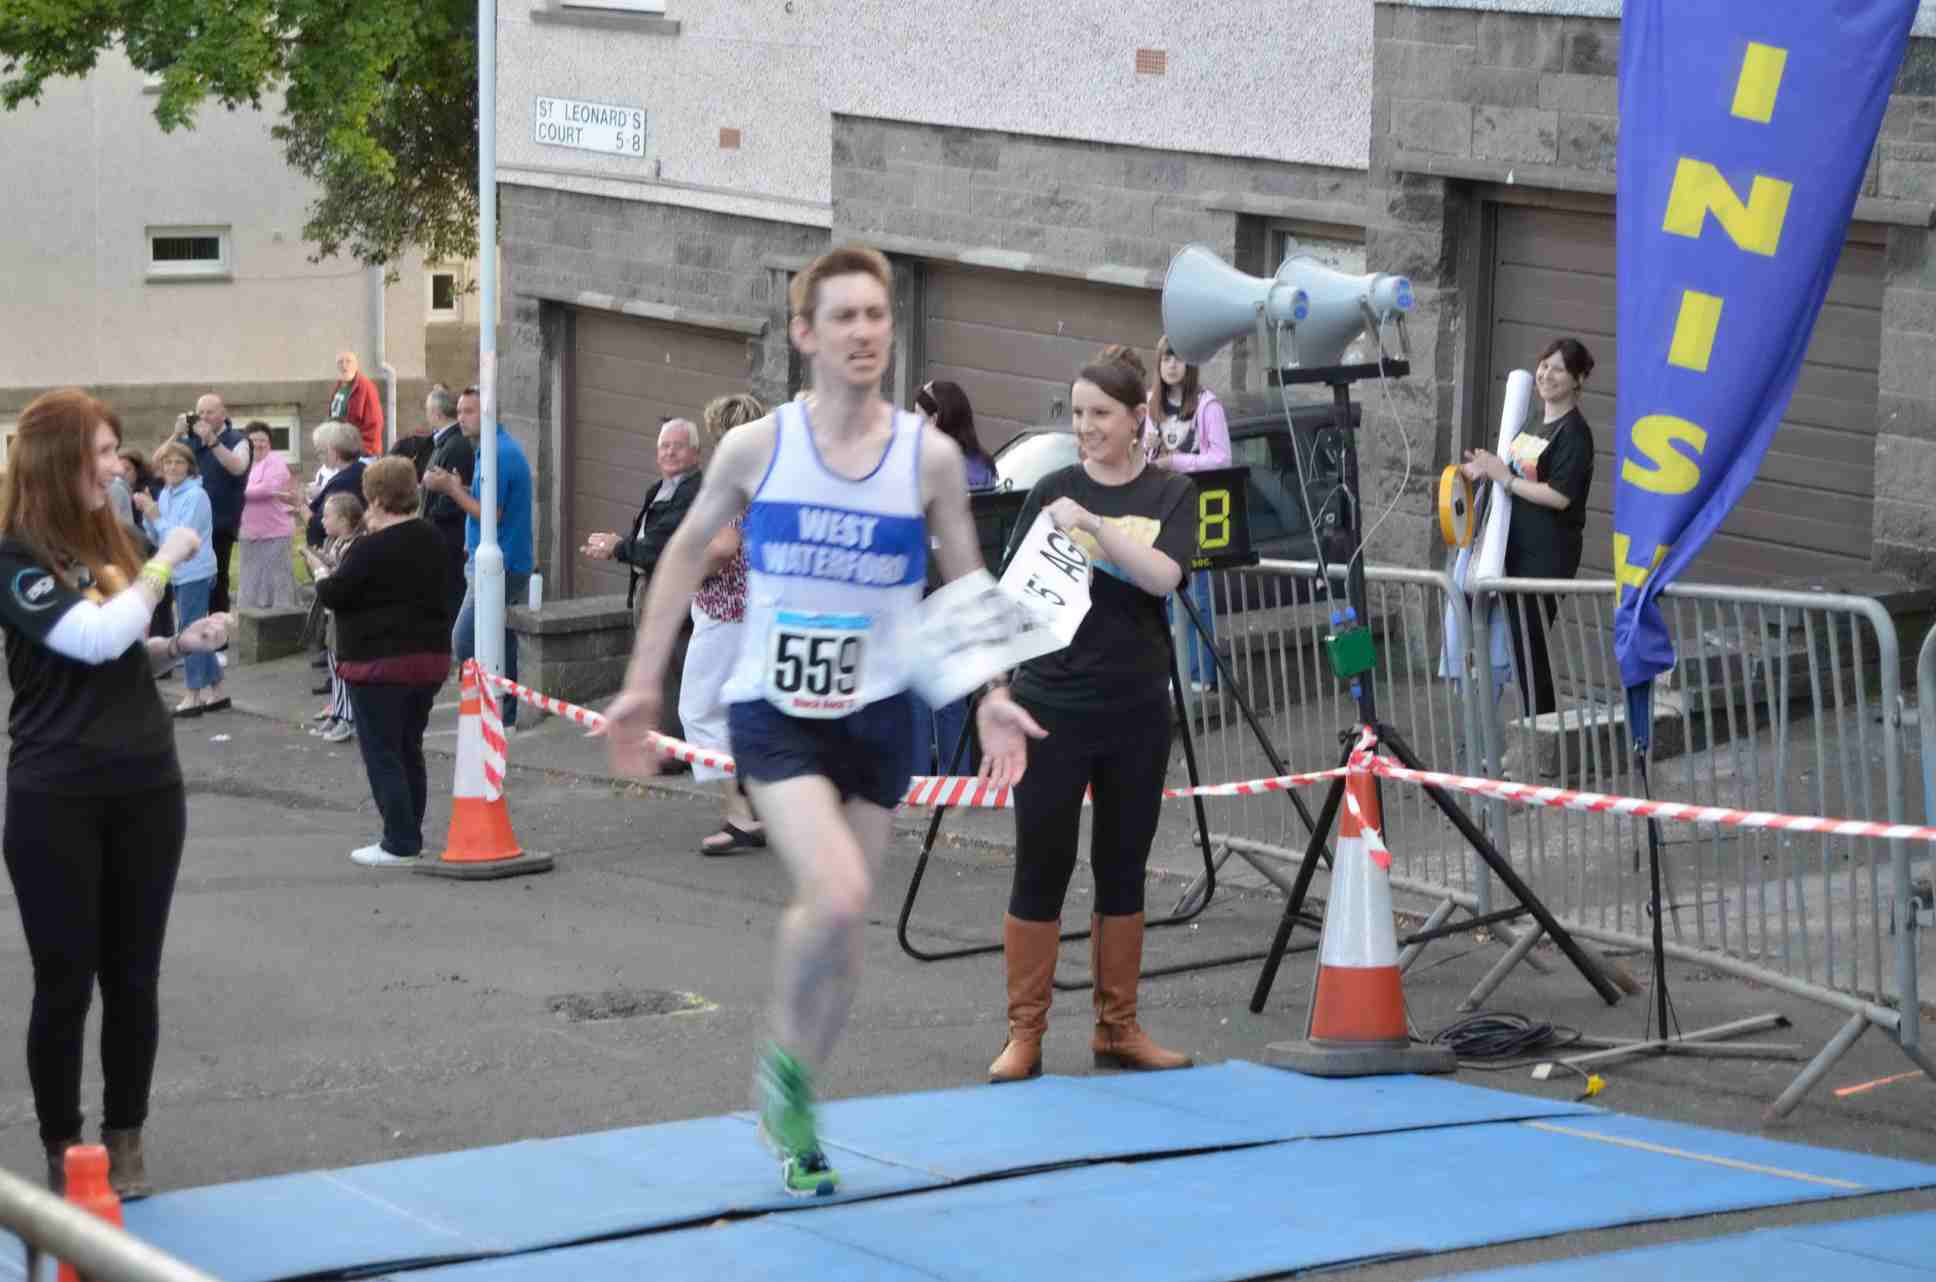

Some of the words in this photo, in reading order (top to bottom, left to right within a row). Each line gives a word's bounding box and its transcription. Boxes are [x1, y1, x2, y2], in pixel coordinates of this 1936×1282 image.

[538, 122, 583, 145] COURT
[539, 100, 554, 118] ST
[565, 103, 641, 130] LEONARD'S
[798, 506, 880, 549] WEST
[1200, 489, 1230, 550] 8
[760, 542, 910, 587] WATERFORD
[775, 632, 863, 695] 559
